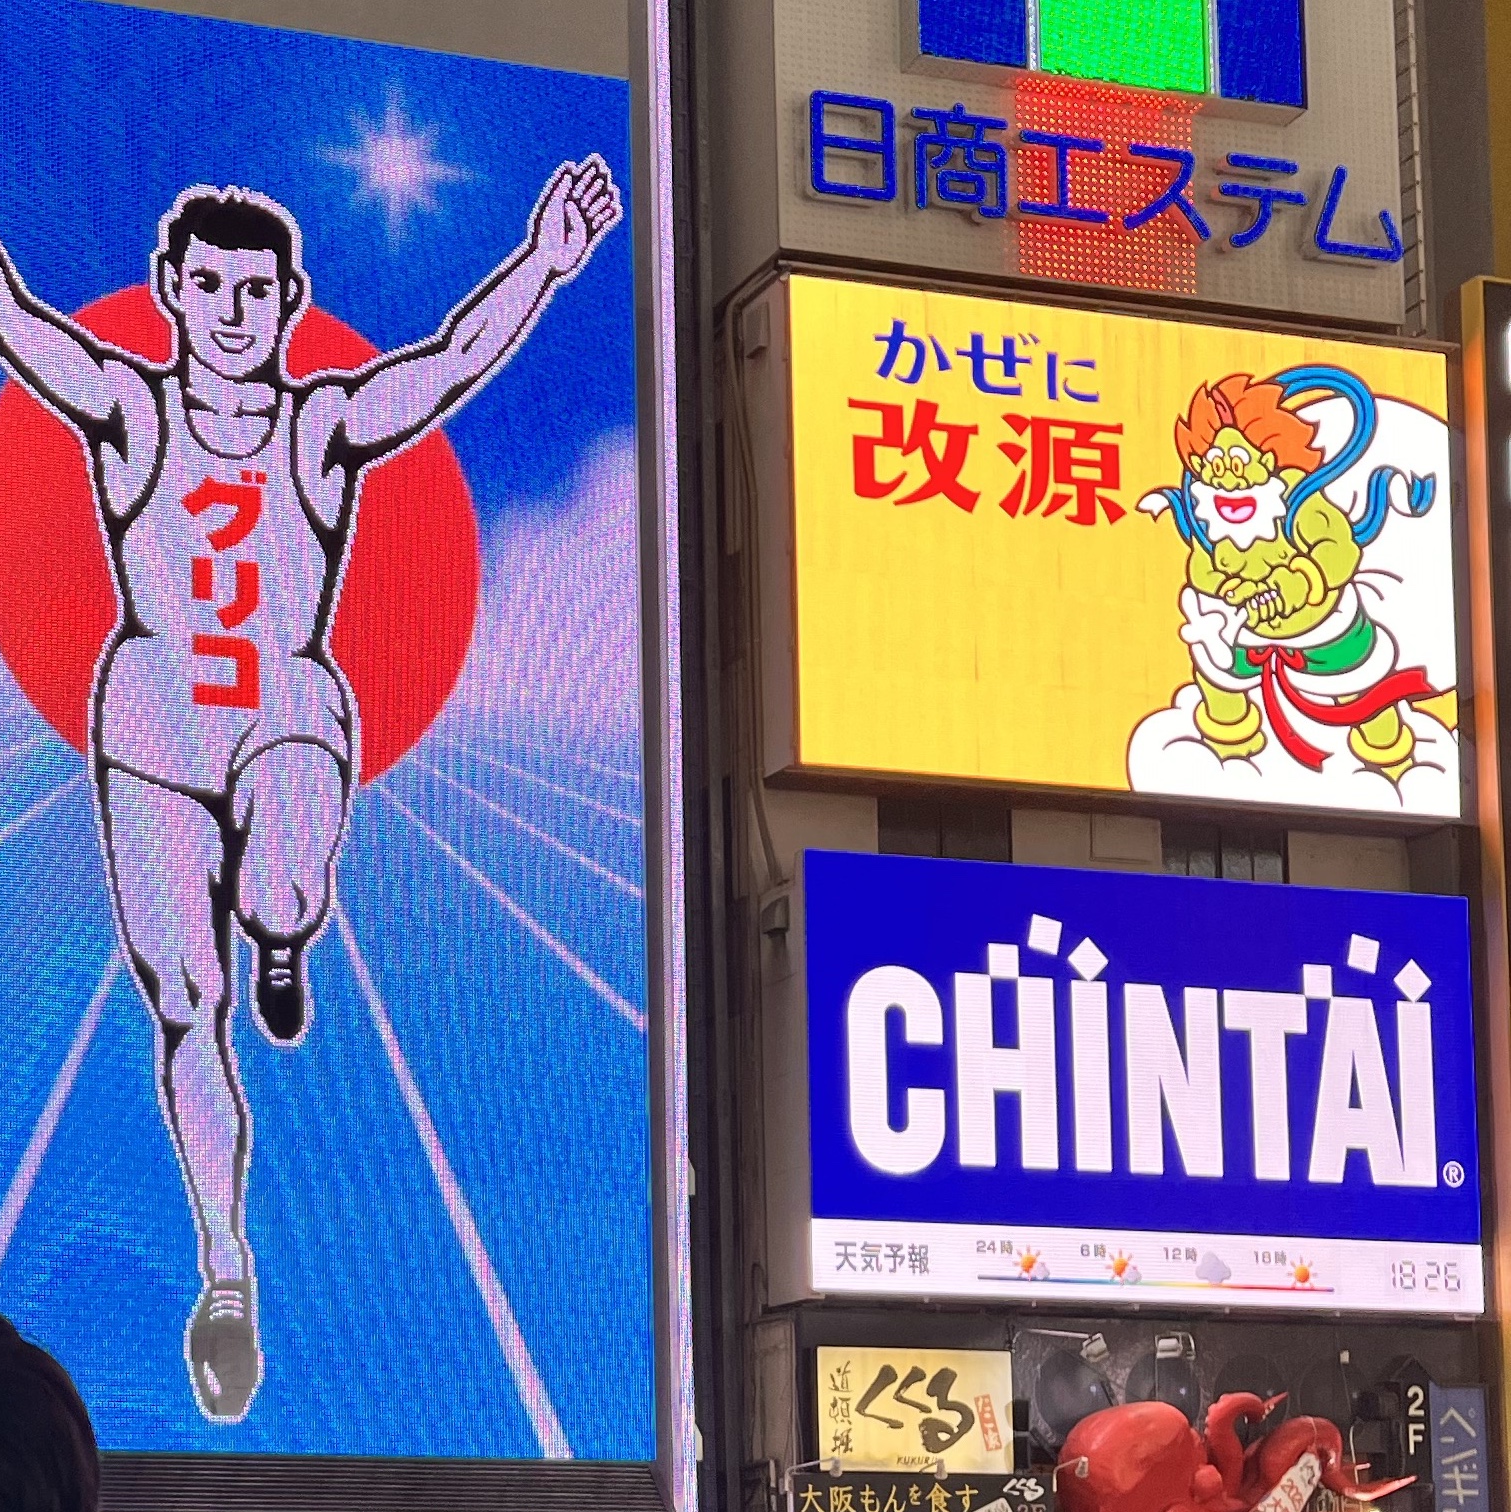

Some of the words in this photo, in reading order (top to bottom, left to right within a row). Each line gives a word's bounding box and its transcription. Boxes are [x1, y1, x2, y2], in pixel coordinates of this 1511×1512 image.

[809, 89, 1404, 262] 日商エステム
[874, 317, 1100, 403] かぜに
[847, 397, 1127, 528] 改源
[182, 470, 268, 710] グリコ
[847, 914, 1438, 1188] CHINTAI
[834, 1240, 930, 1276] 天気予報
[976, 1239, 1013, 1256] 24時
[1163, 1246, 1198, 1263] 12時
[828, 1360, 854, 1454] 道頓堀
[854, 1363, 975, 1454] くくる
[1407, 1385, 1426, 1456] 2F
